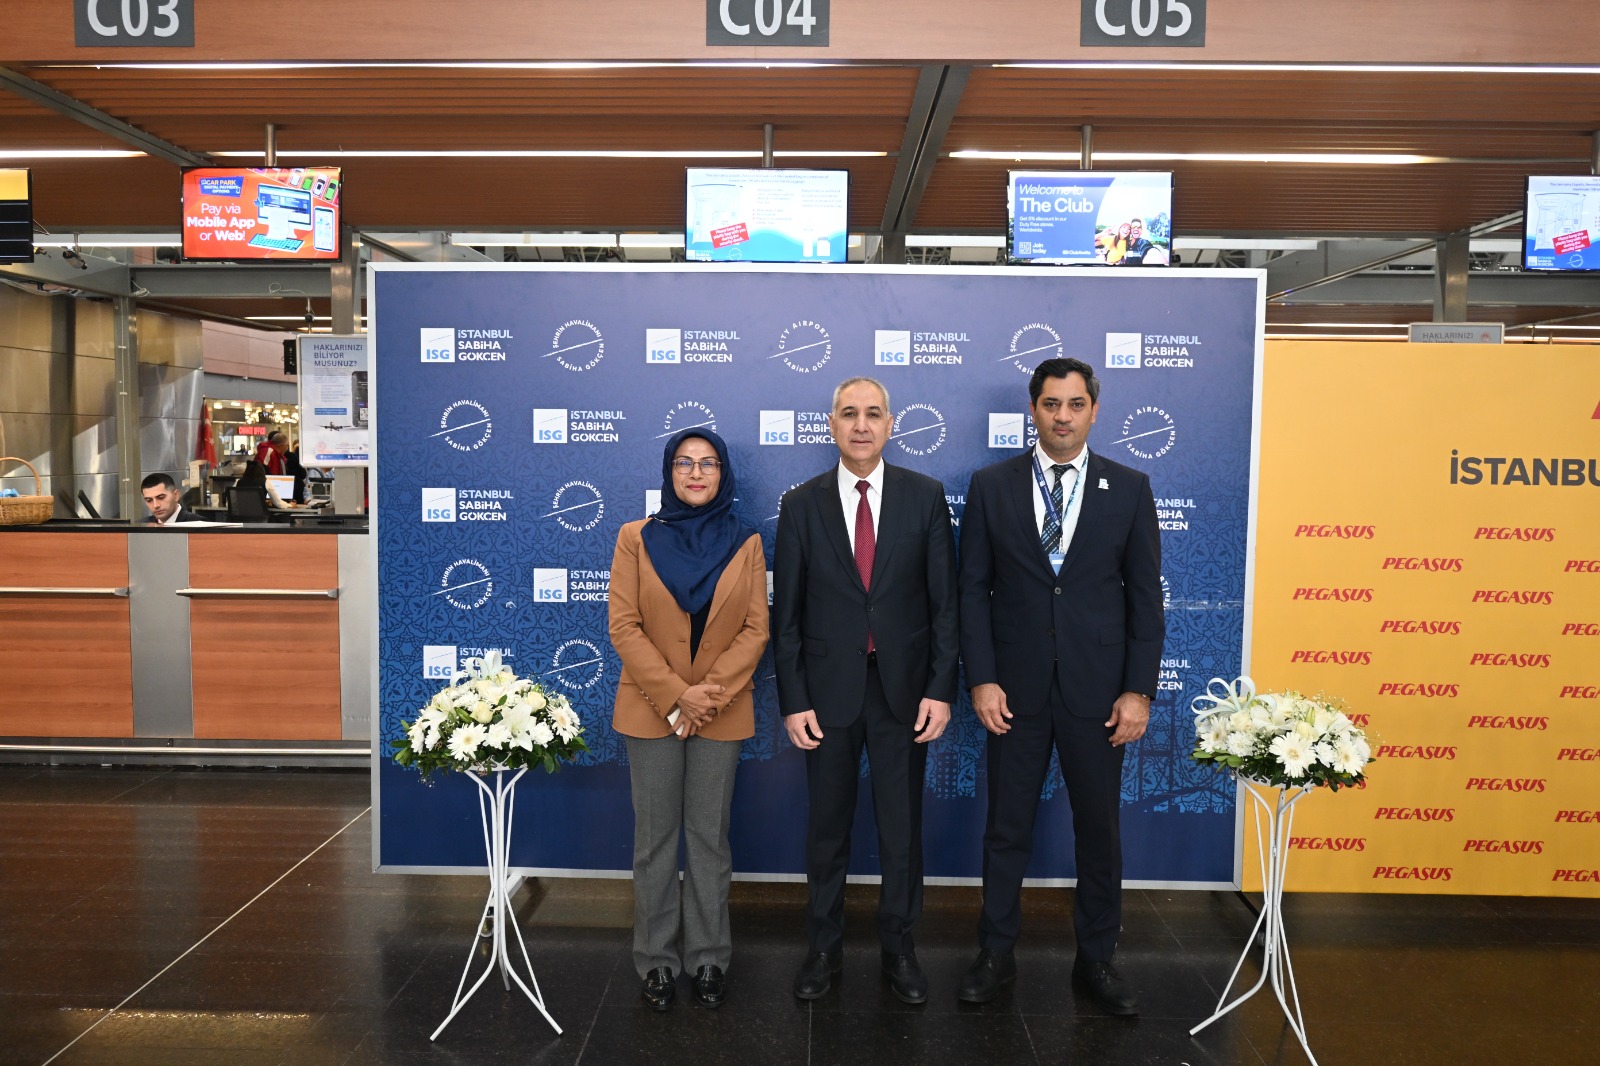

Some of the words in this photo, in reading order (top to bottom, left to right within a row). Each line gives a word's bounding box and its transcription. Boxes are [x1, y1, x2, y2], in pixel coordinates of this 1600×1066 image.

[87, 0, 180, 36] C03
[719, 0, 817, 36] C04
[1094, 0, 1193, 37] C05
[1020, 184, 1070, 195] Welcome
[1072, 185, 1084, 195] to
[202, 203, 222, 215] Pay
[225, 203, 241, 214] via
[1020, 198, 1051, 213] The
[1054, 198, 1094, 213] Club
[187, 216, 227, 227] Mobile
[229, 217, 255, 229] App
[200, 232, 212, 241] or
[215, 230, 245, 241] Web!
[779, 328, 790, 349] CITY
[792, 320, 830, 338] AIRPORT
[427, 350, 450, 359] ISG
[652, 350, 675, 360] ISG
[881, 352, 904, 362] ISG
[1111, 355, 1135, 365] ISG
[1014, 360, 1034, 375] SABİH
[665, 410, 676, 429] CITY
[678, 401, 714, 418] AIRPORT
[1123, 415, 1134, 435] CITY
[1136, 407, 1173, 424] AIRPORT
[539, 430, 562, 440] ISG
[765, 432, 788, 442] ISG
[994, 435, 1017, 445] ISG
[428, 509, 450, 519] ISG
[1295, 525, 1375, 539] PEGASUS
[1474, 528, 1554, 542] PEGASUS
[1383, 558, 1463, 572] PEGASUS
[539, 589, 562, 599] ISG
[1293, 588, 1373, 602] PEGASUS
[1472, 591, 1552, 605] PEGASUS
[1380, 621, 1461, 635] PEGASUS
[1291, 651, 1371, 665] PEGASUS
[1471, 654, 1550, 668] PEGASUS
[429, 666, 451, 676] ISG
[1378, 684, 1458, 698] PEGASUS
[1469, 716, 1547, 730] PEGASUS
[1377, 746, 1456, 760] PEGASUS
[1465, 778, 1545, 792] PEGASUS
[1375, 808, 1454, 822] PEGASUS
[1288, 838, 1366, 852] PEGASUS
[1464, 840, 1543, 854] PEGASUS
[1373, 867, 1451, 881] PEGASUS
[1552, 869, 1600, 881] PEGA
